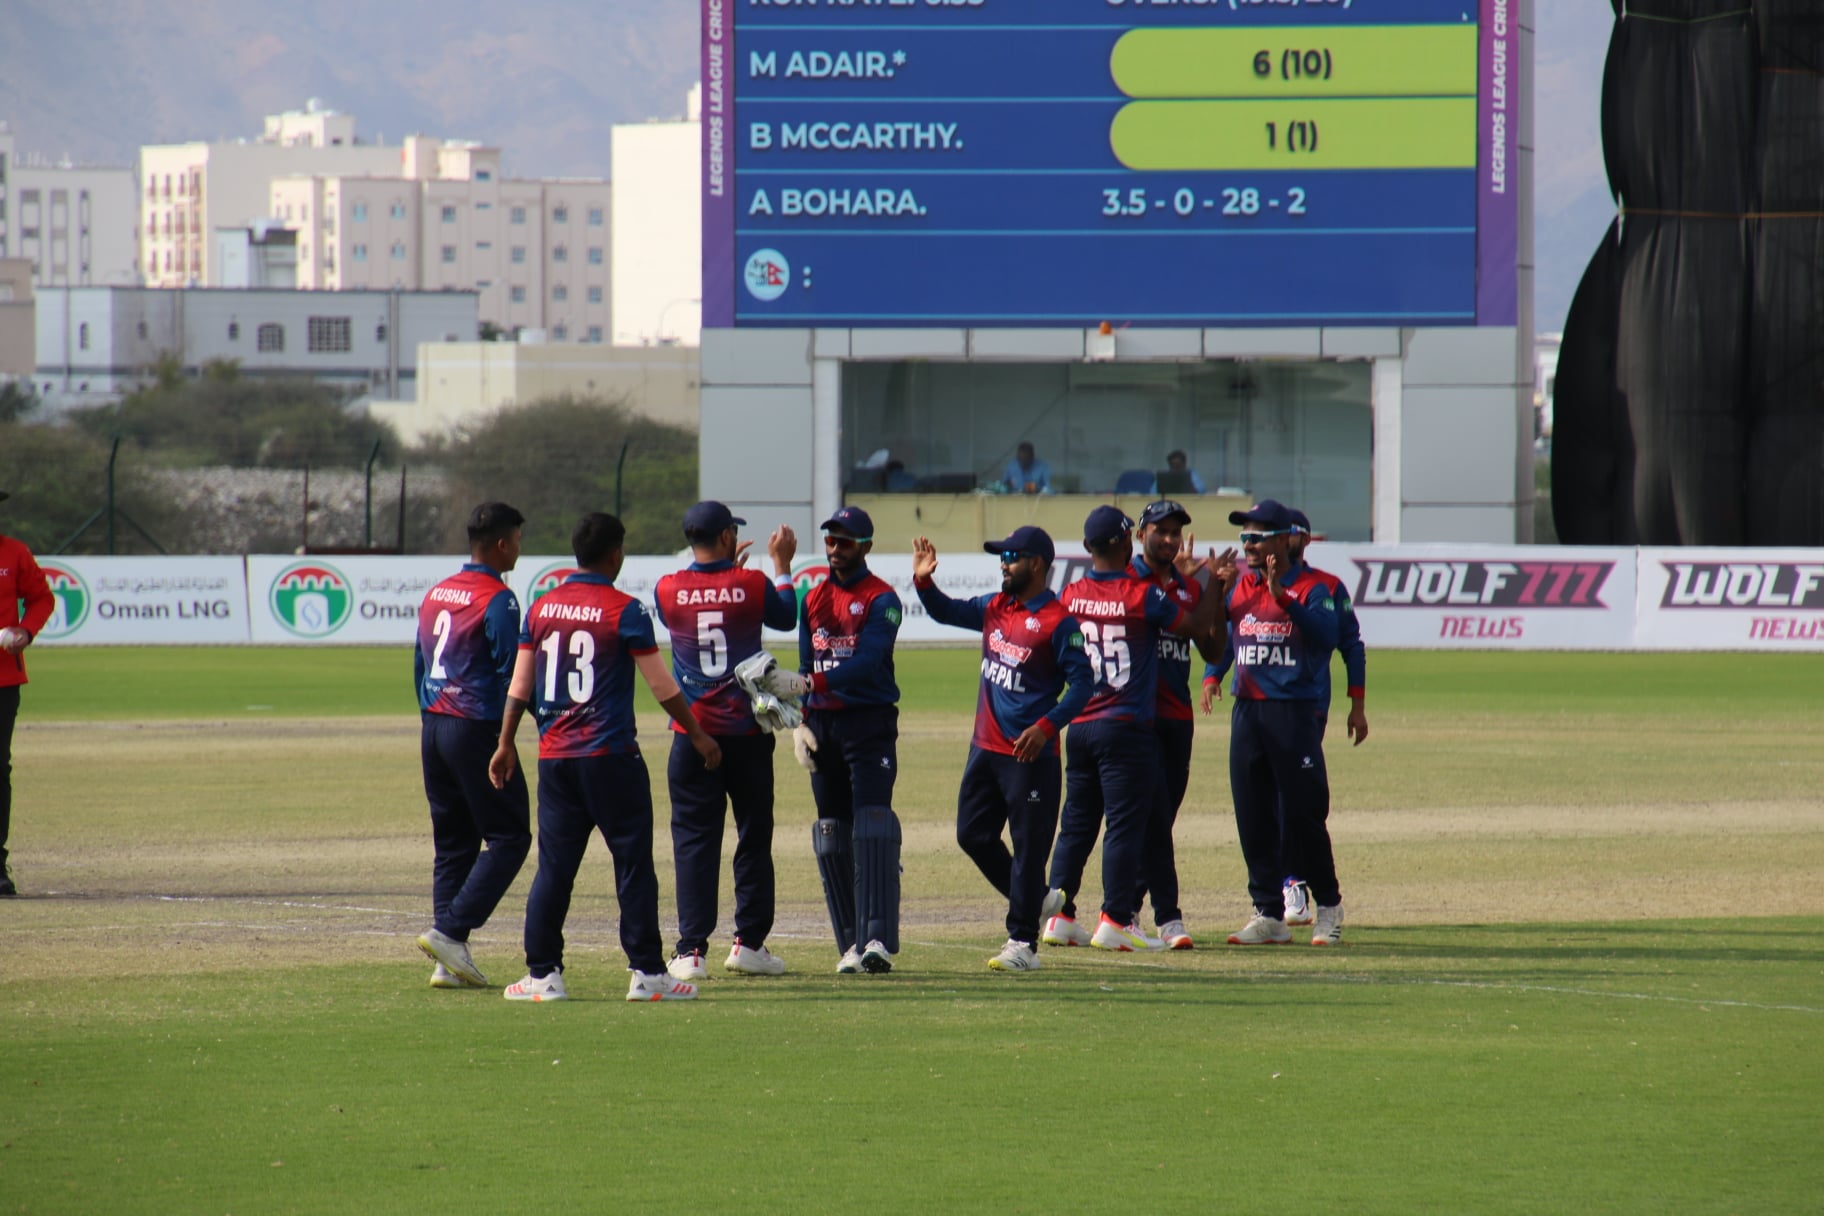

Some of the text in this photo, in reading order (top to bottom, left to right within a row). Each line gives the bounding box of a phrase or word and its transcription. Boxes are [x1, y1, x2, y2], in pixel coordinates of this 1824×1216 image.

[709, 44, 724, 113] LEAGUE
[750, 51, 776, 78] M
[1253, 48, 1332, 81] 6 (10)
[1492, 39, 1507, 110] LEAGUE
[750, 122, 963, 149] B MCCARTHY.
[1265, 120, 1318, 152] 1 (1)
[709, 115, 724, 197] LEGENDS
[1492, 112, 1506, 194] LEGENDS
[749, 188, 927, 215] A BOHARA.
[1102, 188, 1147, 215] 3.5
[1173, 187, 1195, 215] 0
[1222, 187, 1260, 215] 28
[1287, 186, 1307, 214] 2
[98, 601, 230, 619] Oman LNG
[430, 587, 472, 605] KUSHAL
[676, 587, 746, 605] SARAD
[1068, 597, 1126, 617] JITENDRA
[538, 603, 602, 623] AVINASH
[429, 609, 452, 680] 2
[697, 610, 728, 678] 5
[1080, 620, 1131, 688] 65
[1158, 639, 1189, 662] PAL
[1237, 645, 1297, 667] NEPAL
[541, 630, 595, 704] 13
[981, 657, 1026, 693] NEPAL
